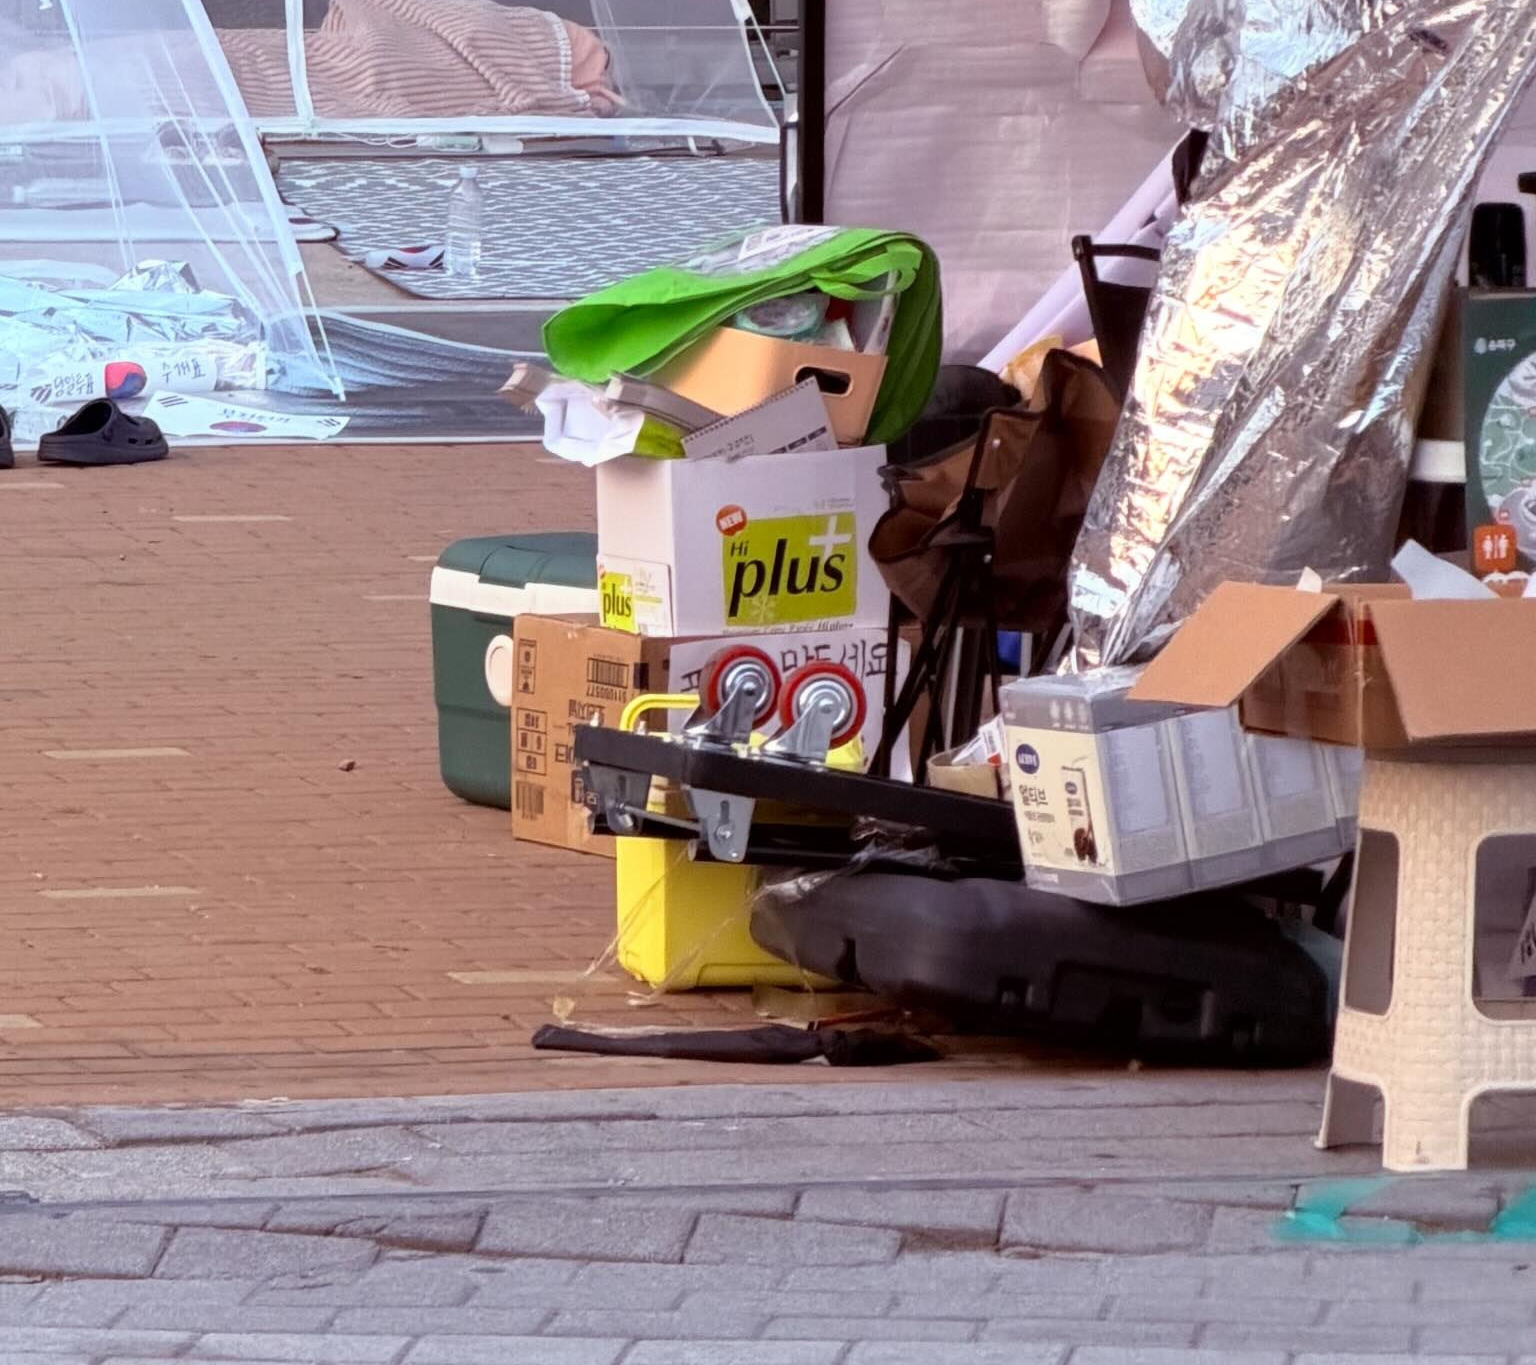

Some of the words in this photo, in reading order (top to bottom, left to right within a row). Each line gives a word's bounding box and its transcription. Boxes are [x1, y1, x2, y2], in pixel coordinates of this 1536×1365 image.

[730, 541, 748, 556] Hi
[728, 538, 845, 618] plus
[603, 583, 632, 623] plus
